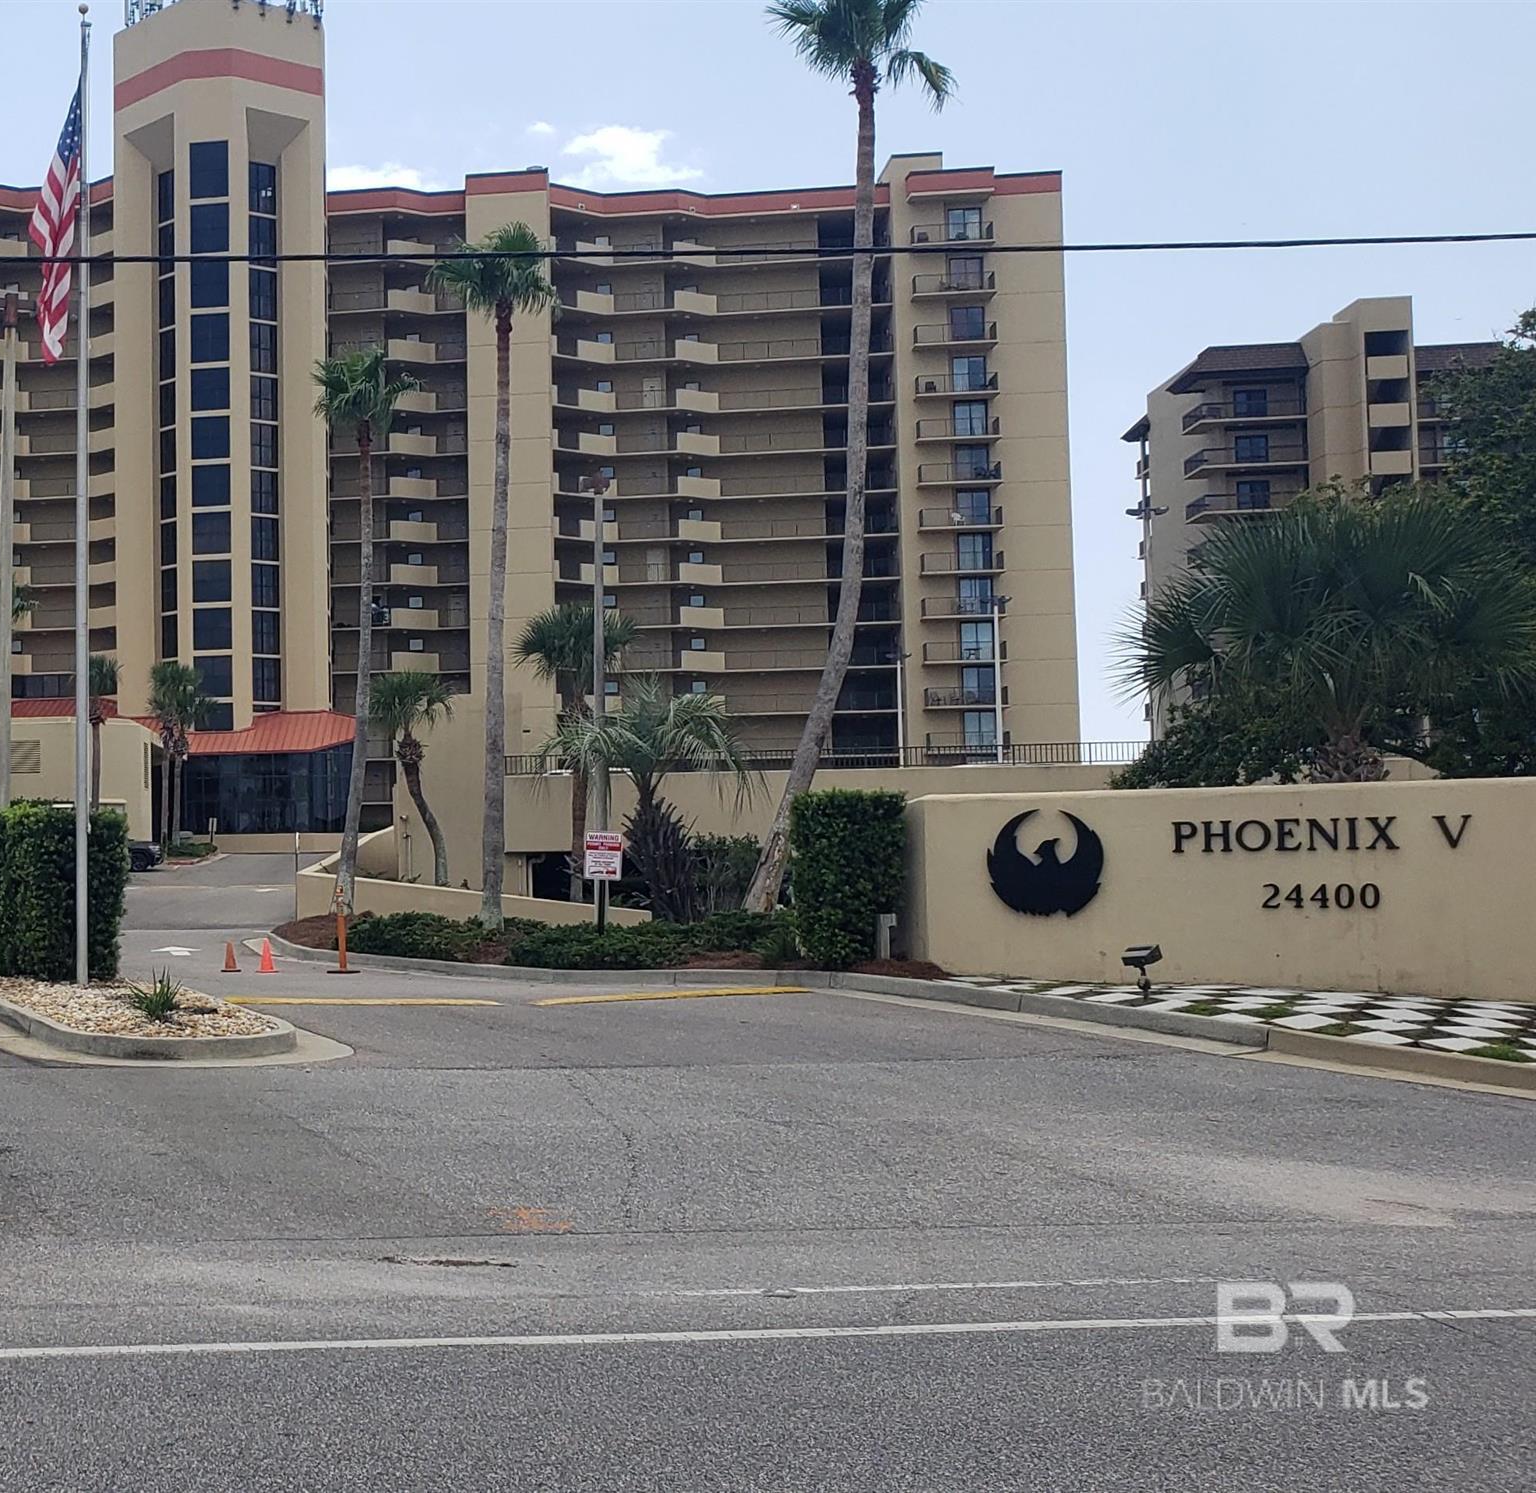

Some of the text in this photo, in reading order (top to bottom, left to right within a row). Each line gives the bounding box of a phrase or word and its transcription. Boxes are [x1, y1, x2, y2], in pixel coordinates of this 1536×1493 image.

[588, 833, 620, 842] WARNING
[1171, 814, 1473, 855] PHOENIX V
[1261, 882, 1381, 911] 24400
